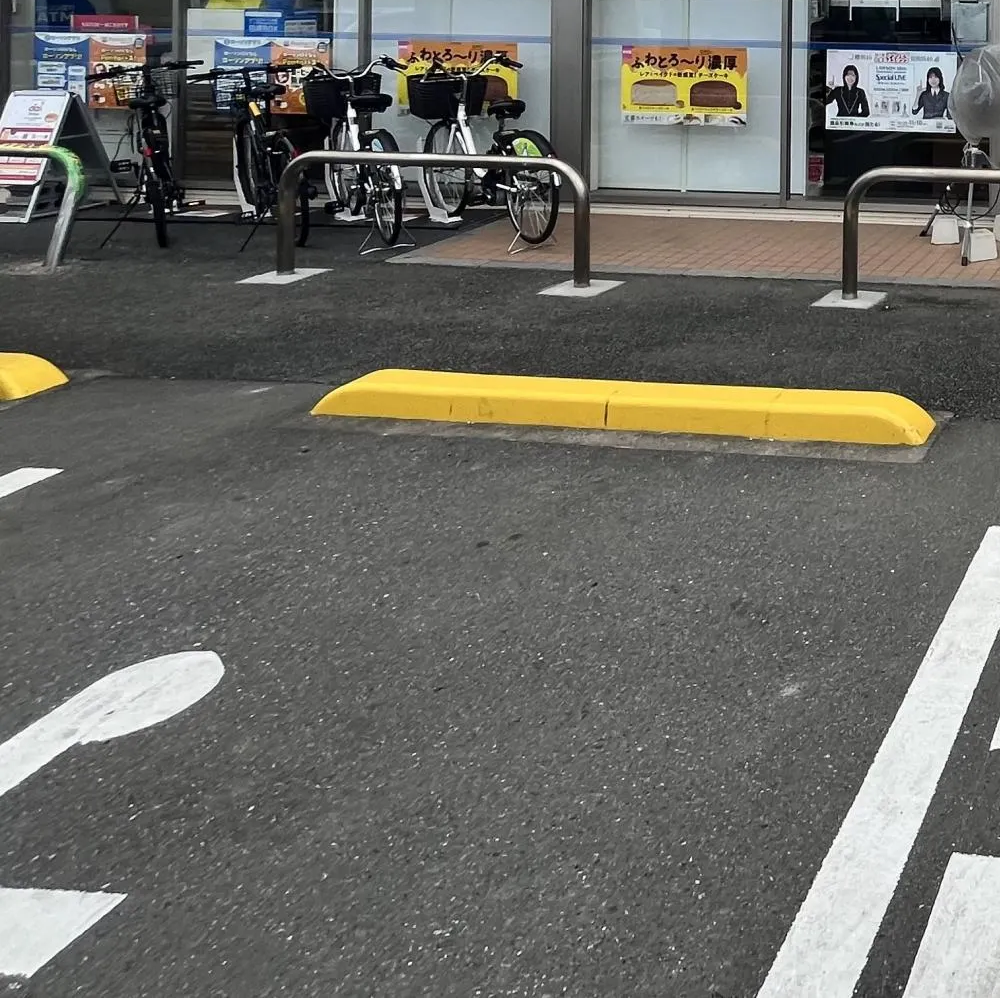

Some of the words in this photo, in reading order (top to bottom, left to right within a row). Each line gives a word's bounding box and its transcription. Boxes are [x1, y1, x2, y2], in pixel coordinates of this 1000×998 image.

[632, 52, 738, 70] ふわとろ〜り濃厚
